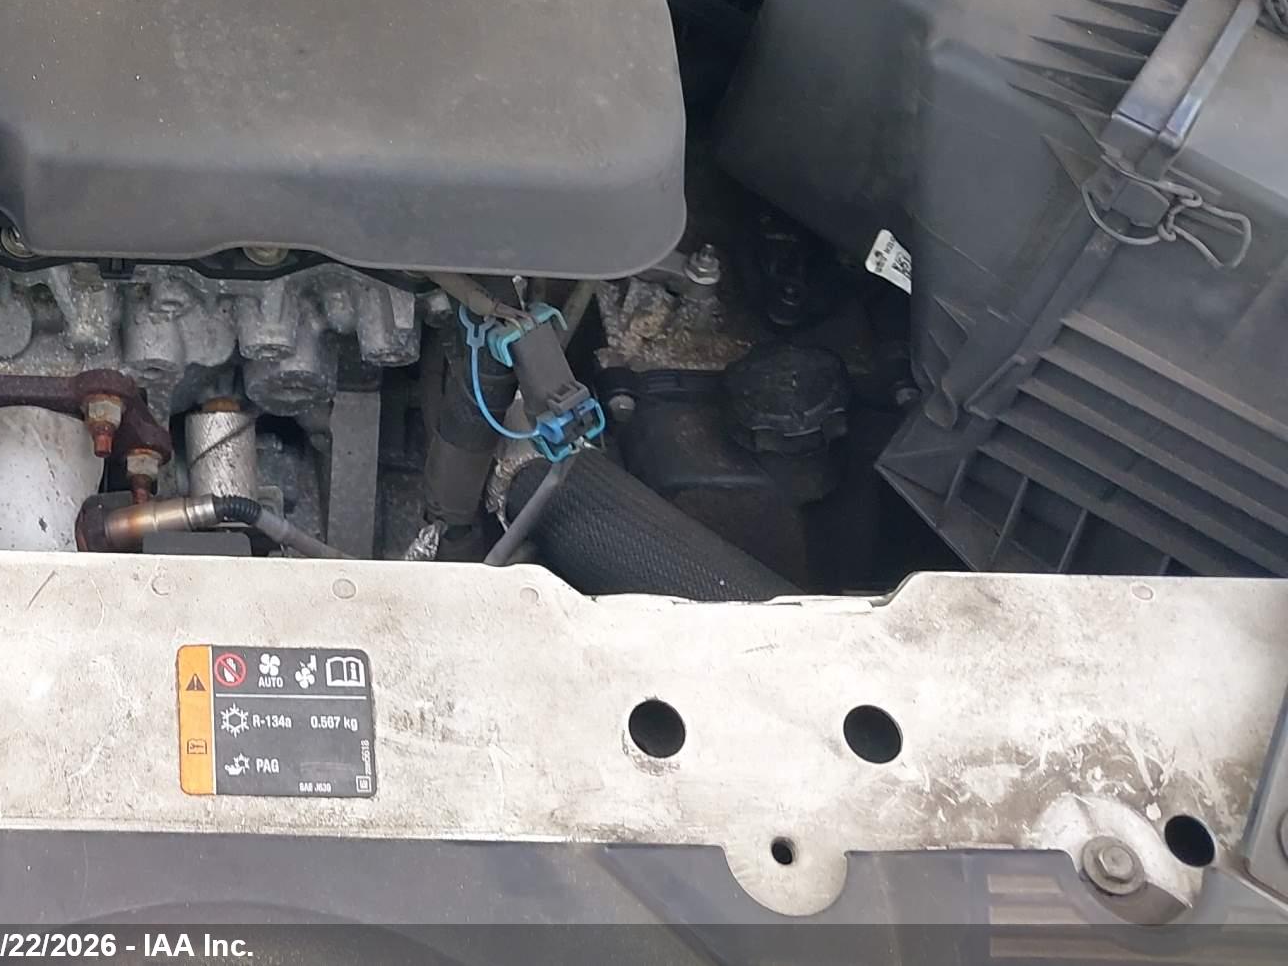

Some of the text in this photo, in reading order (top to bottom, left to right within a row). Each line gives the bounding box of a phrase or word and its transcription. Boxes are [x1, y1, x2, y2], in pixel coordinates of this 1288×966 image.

[258, 677, 284, 689] AUTO
[252, 715, 292, 729] R-134a
[343, 715, 359, 732] kg
[256, 758, 280, 773] PAG
